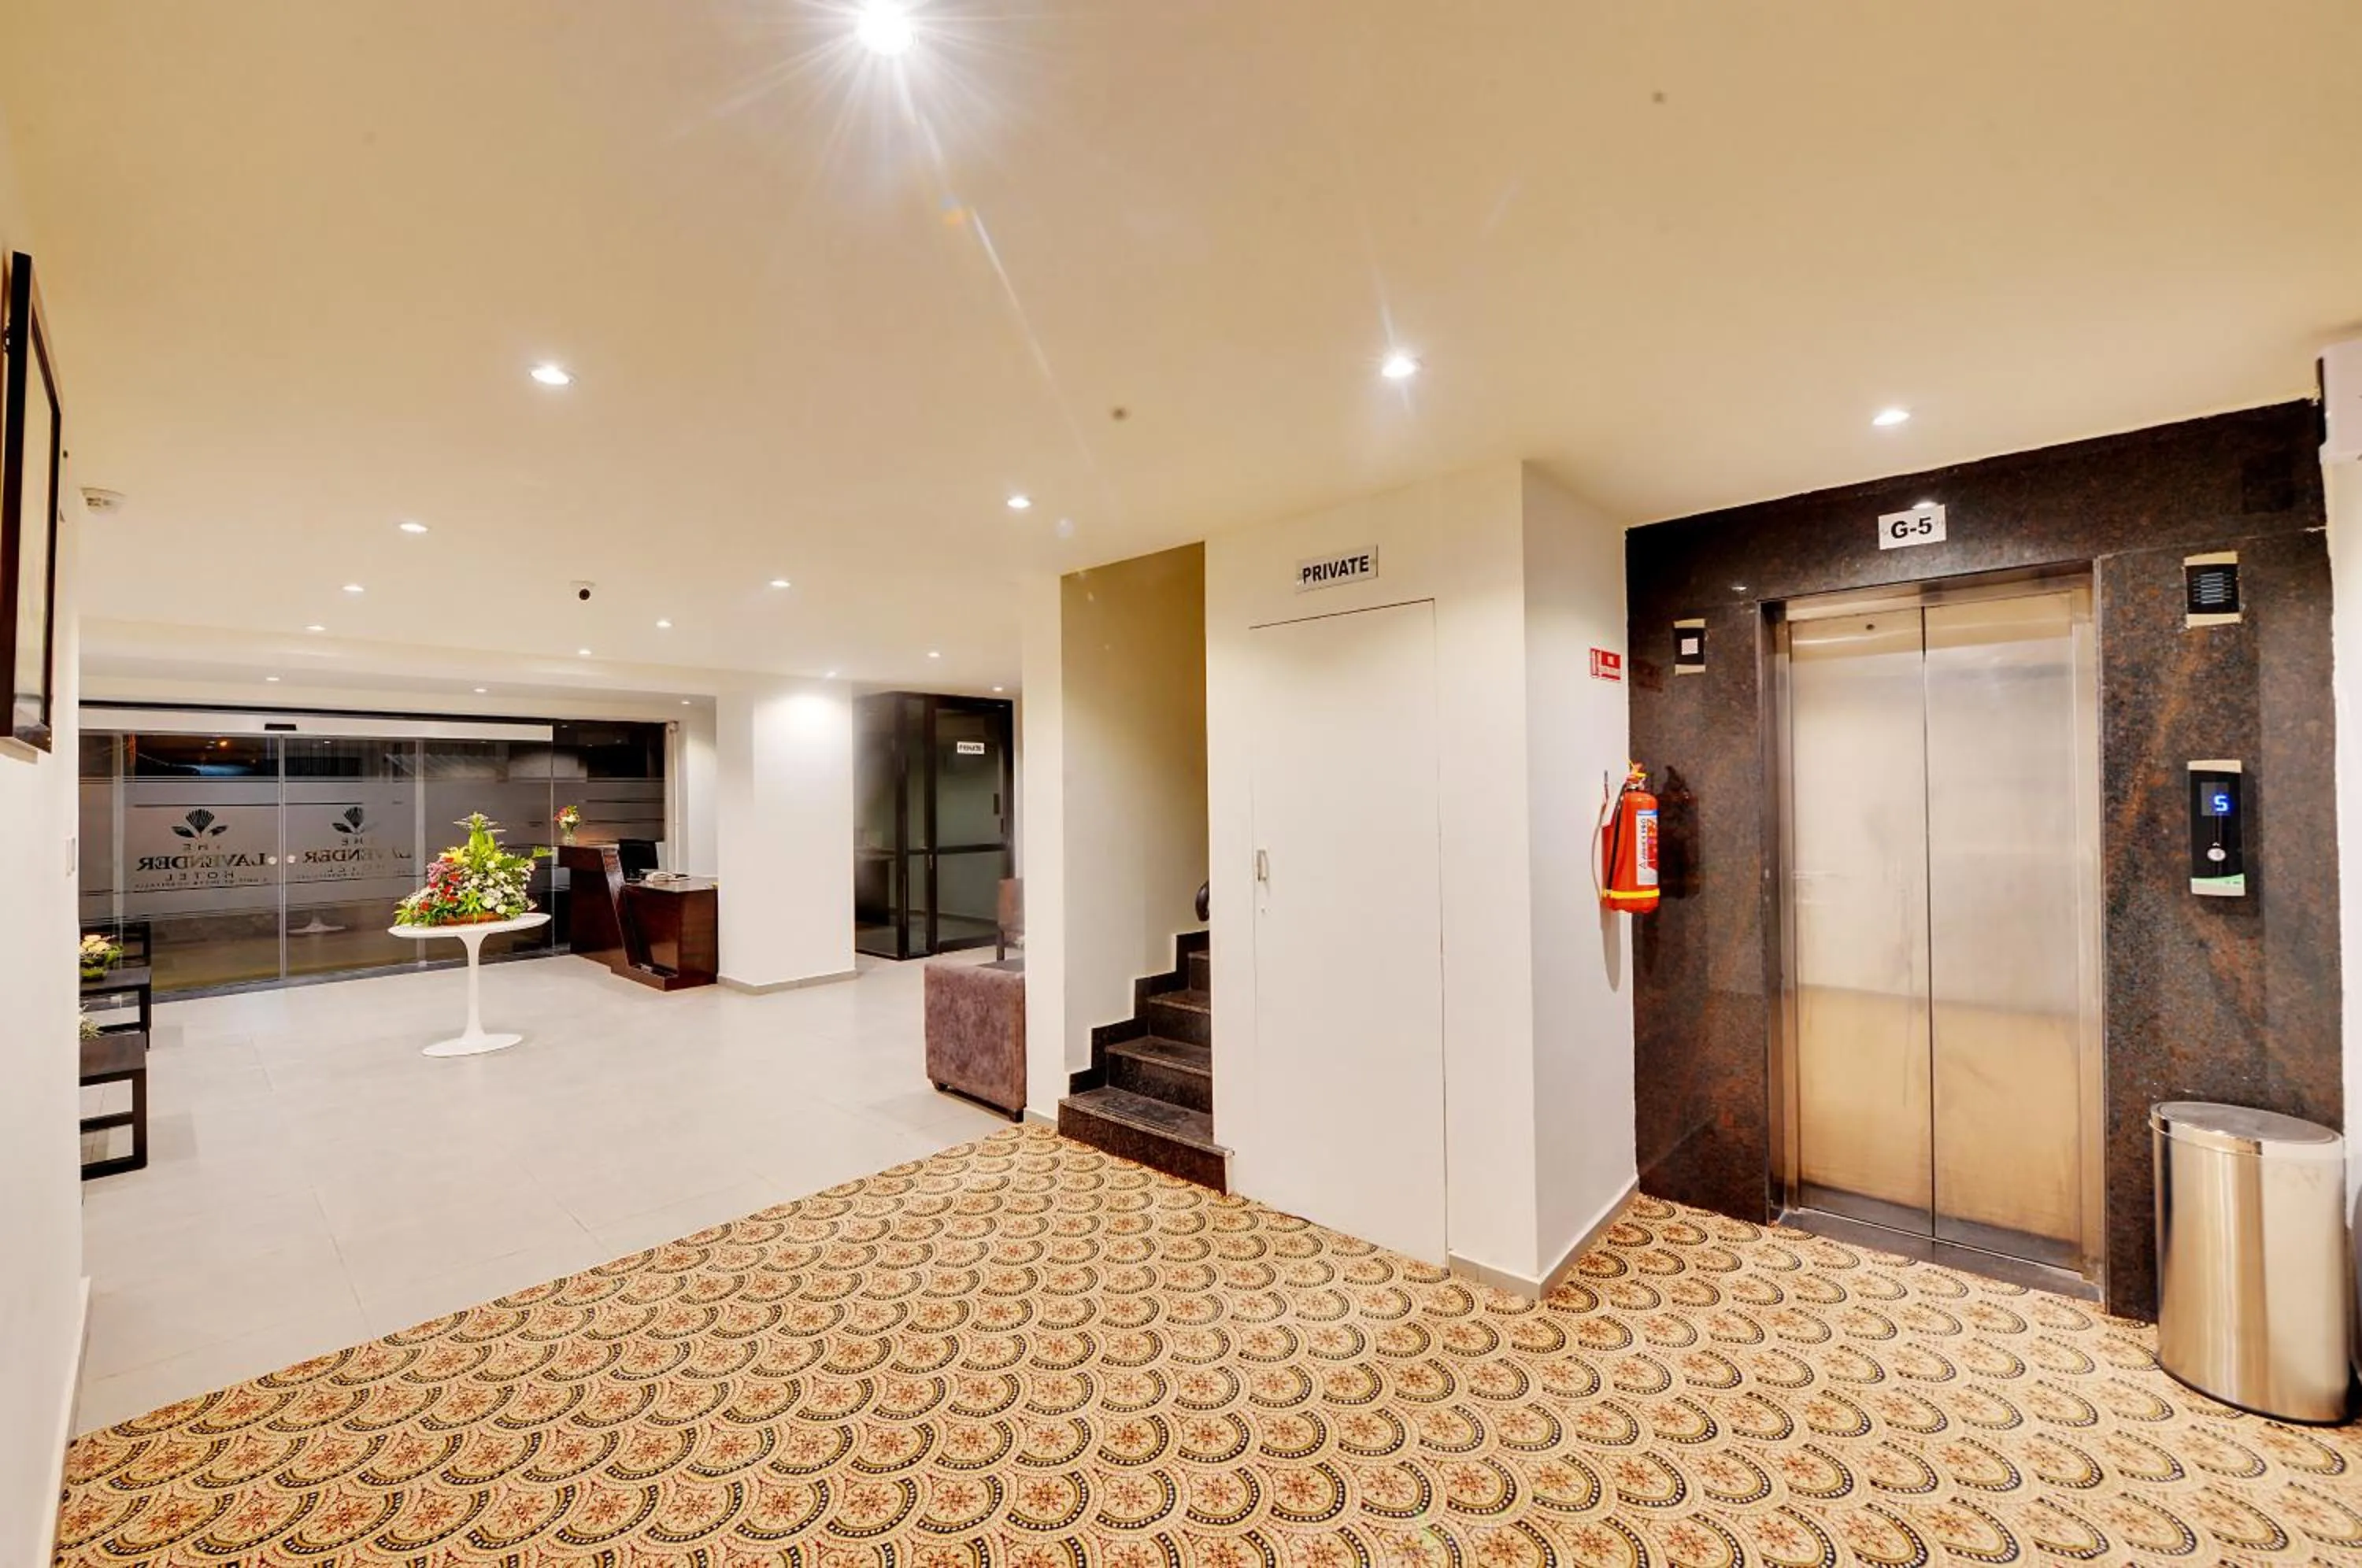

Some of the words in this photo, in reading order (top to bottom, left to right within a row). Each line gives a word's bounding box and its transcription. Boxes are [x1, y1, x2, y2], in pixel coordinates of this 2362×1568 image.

[1890, 516, 1933, 539] G-5
[1301, 555, 1369, 584] PRIVATE
[2213, 794, 2229, 812] 5
